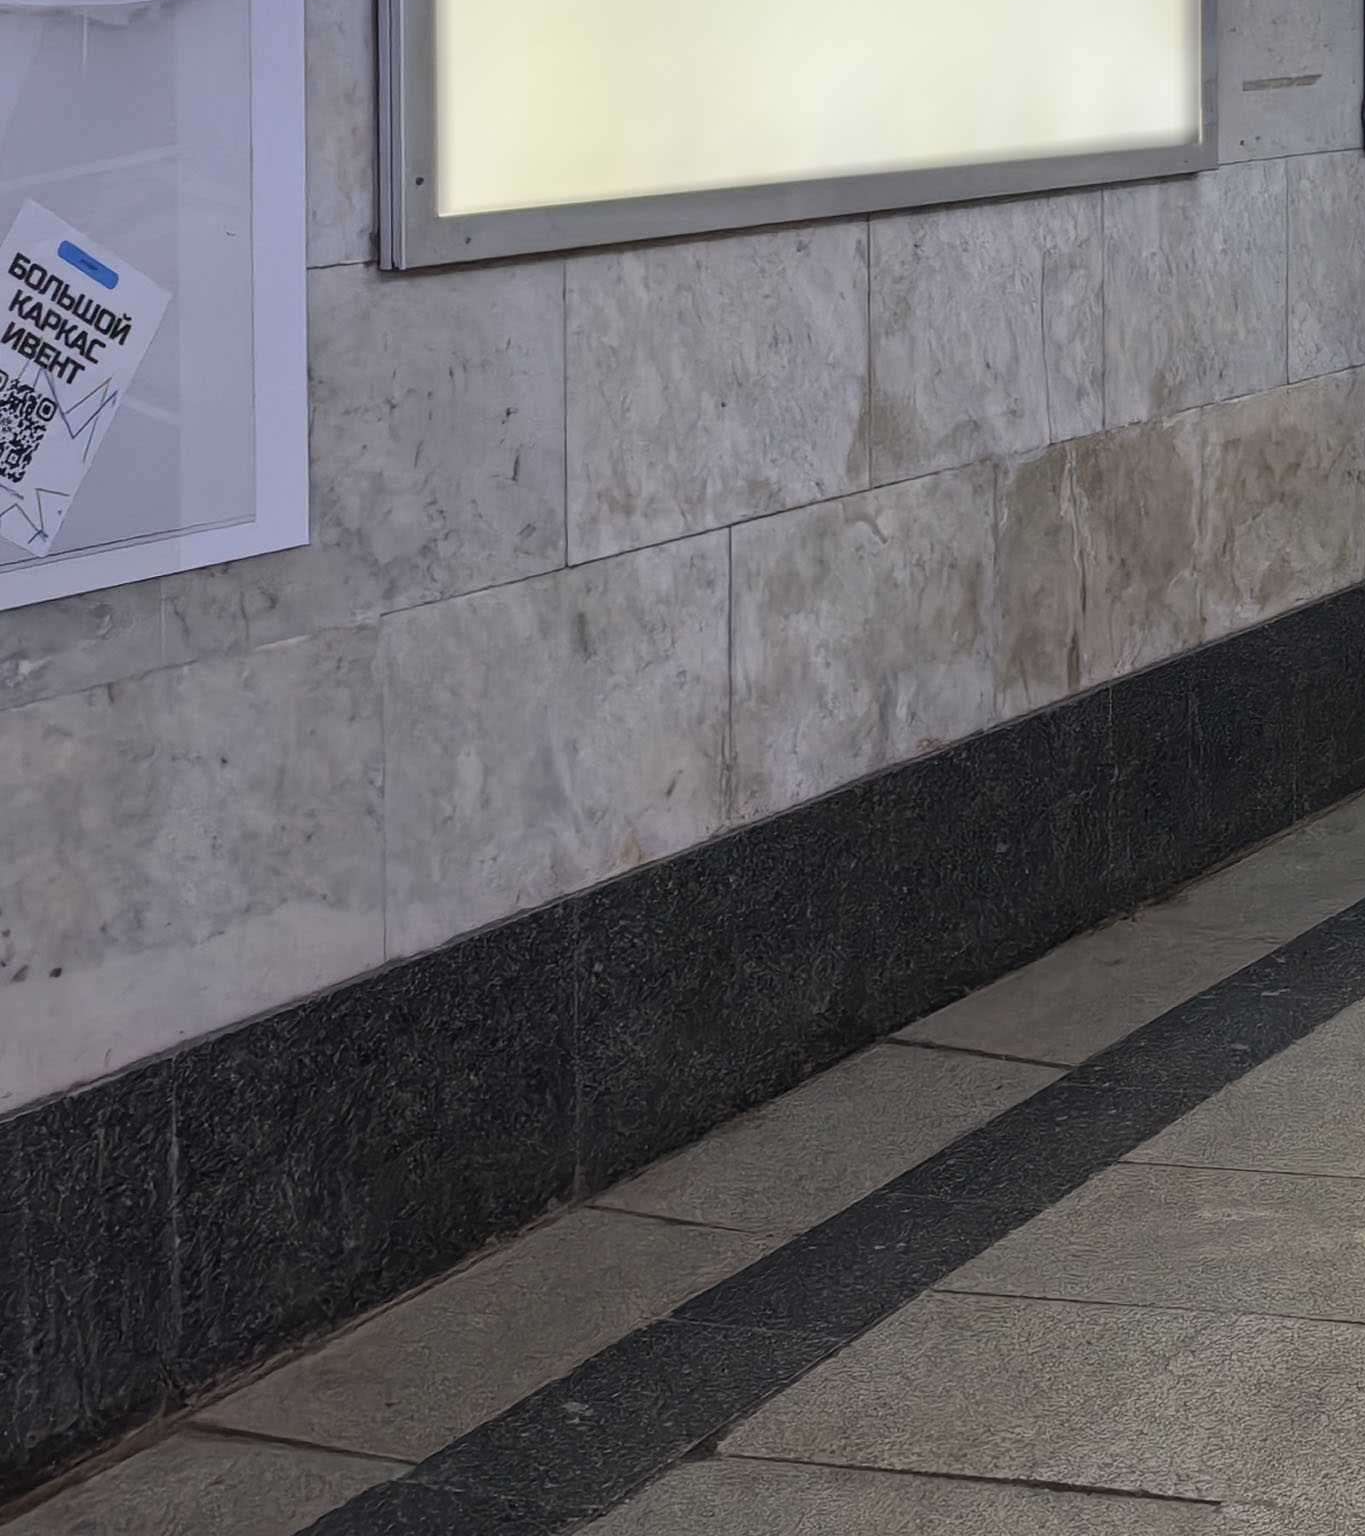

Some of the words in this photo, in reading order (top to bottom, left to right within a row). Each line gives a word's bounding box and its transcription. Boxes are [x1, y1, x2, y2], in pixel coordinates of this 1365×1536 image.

[7, 251, 133, 347] БОЛЬШОЙ
[8, 289, 107, 365] КАРКАС
[1, 321, 86, 385] ИВЕНТ
